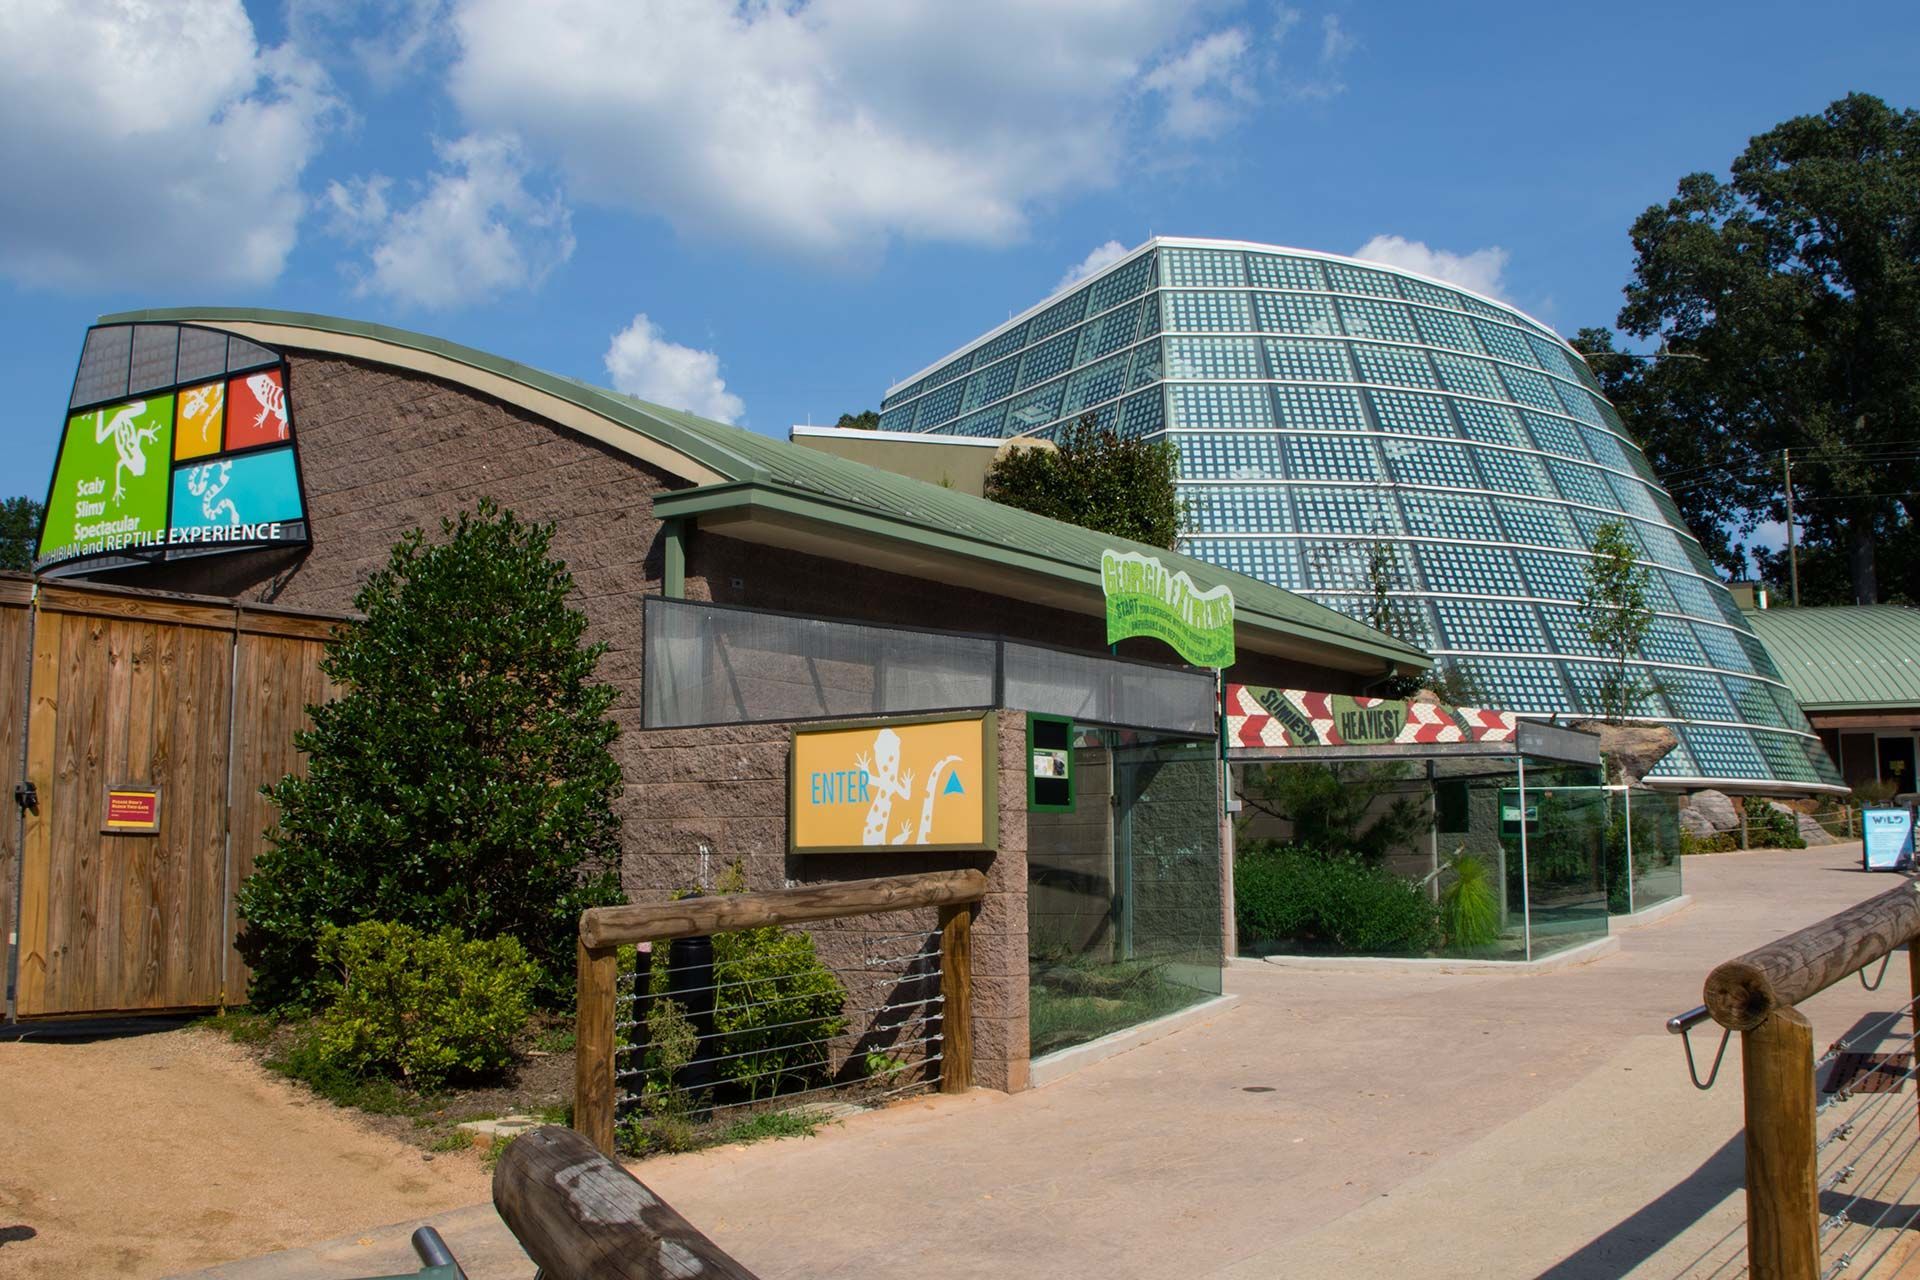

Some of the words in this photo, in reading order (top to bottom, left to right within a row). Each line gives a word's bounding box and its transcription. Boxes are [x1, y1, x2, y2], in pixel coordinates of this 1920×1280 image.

[77, 476, 105, 497] Scaly
[75, 501, 105, 519] Slimy
[74, 514, 140, 541] Spectacular
[81, 540, 104, 555] and
[106, 529, 165, 551] REPTILE
[168, 522, 281, 545] EXPERIENCE
[1103, 555, 1168, 602] GEORGIA
[1169, 578, 1233, 631] EXTREMES
[1116, 598, 1138, 619] START
[1261, 689, 1319, 744] SLIMIEST
[1342, 709, 1399, 740] HEAVIEST
[811, 770, 870, 805] ENTER
